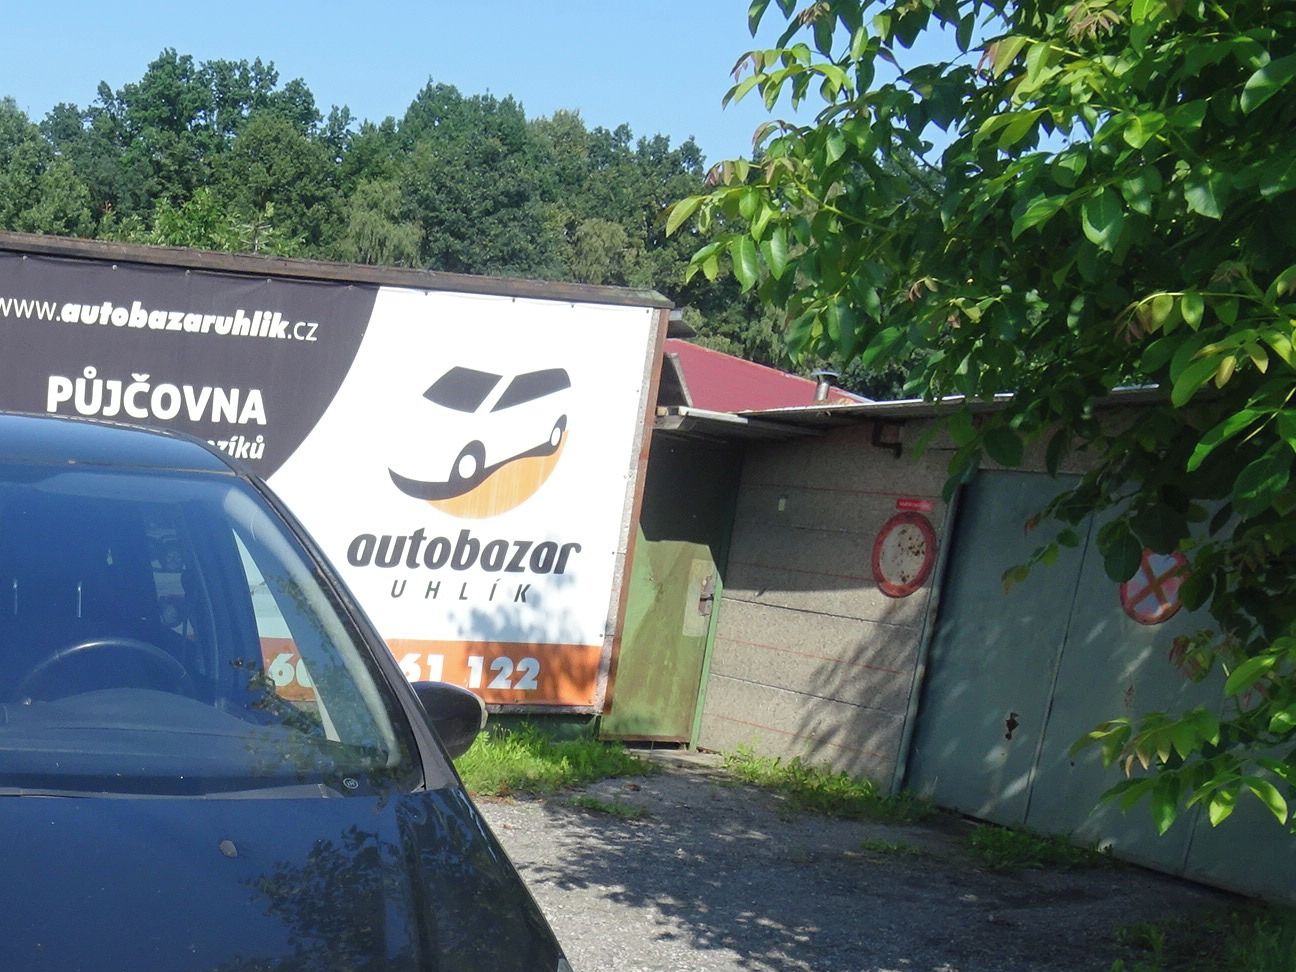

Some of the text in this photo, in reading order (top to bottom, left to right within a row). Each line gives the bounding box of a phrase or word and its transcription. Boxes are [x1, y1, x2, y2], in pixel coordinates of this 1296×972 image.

[46, 366, 267, 425] PŮJČOVNA
[346, 527, 582, 574] autobazar
[390, 578, 532, 603] UHLÍK
[467, 655, 540, 690] 122
